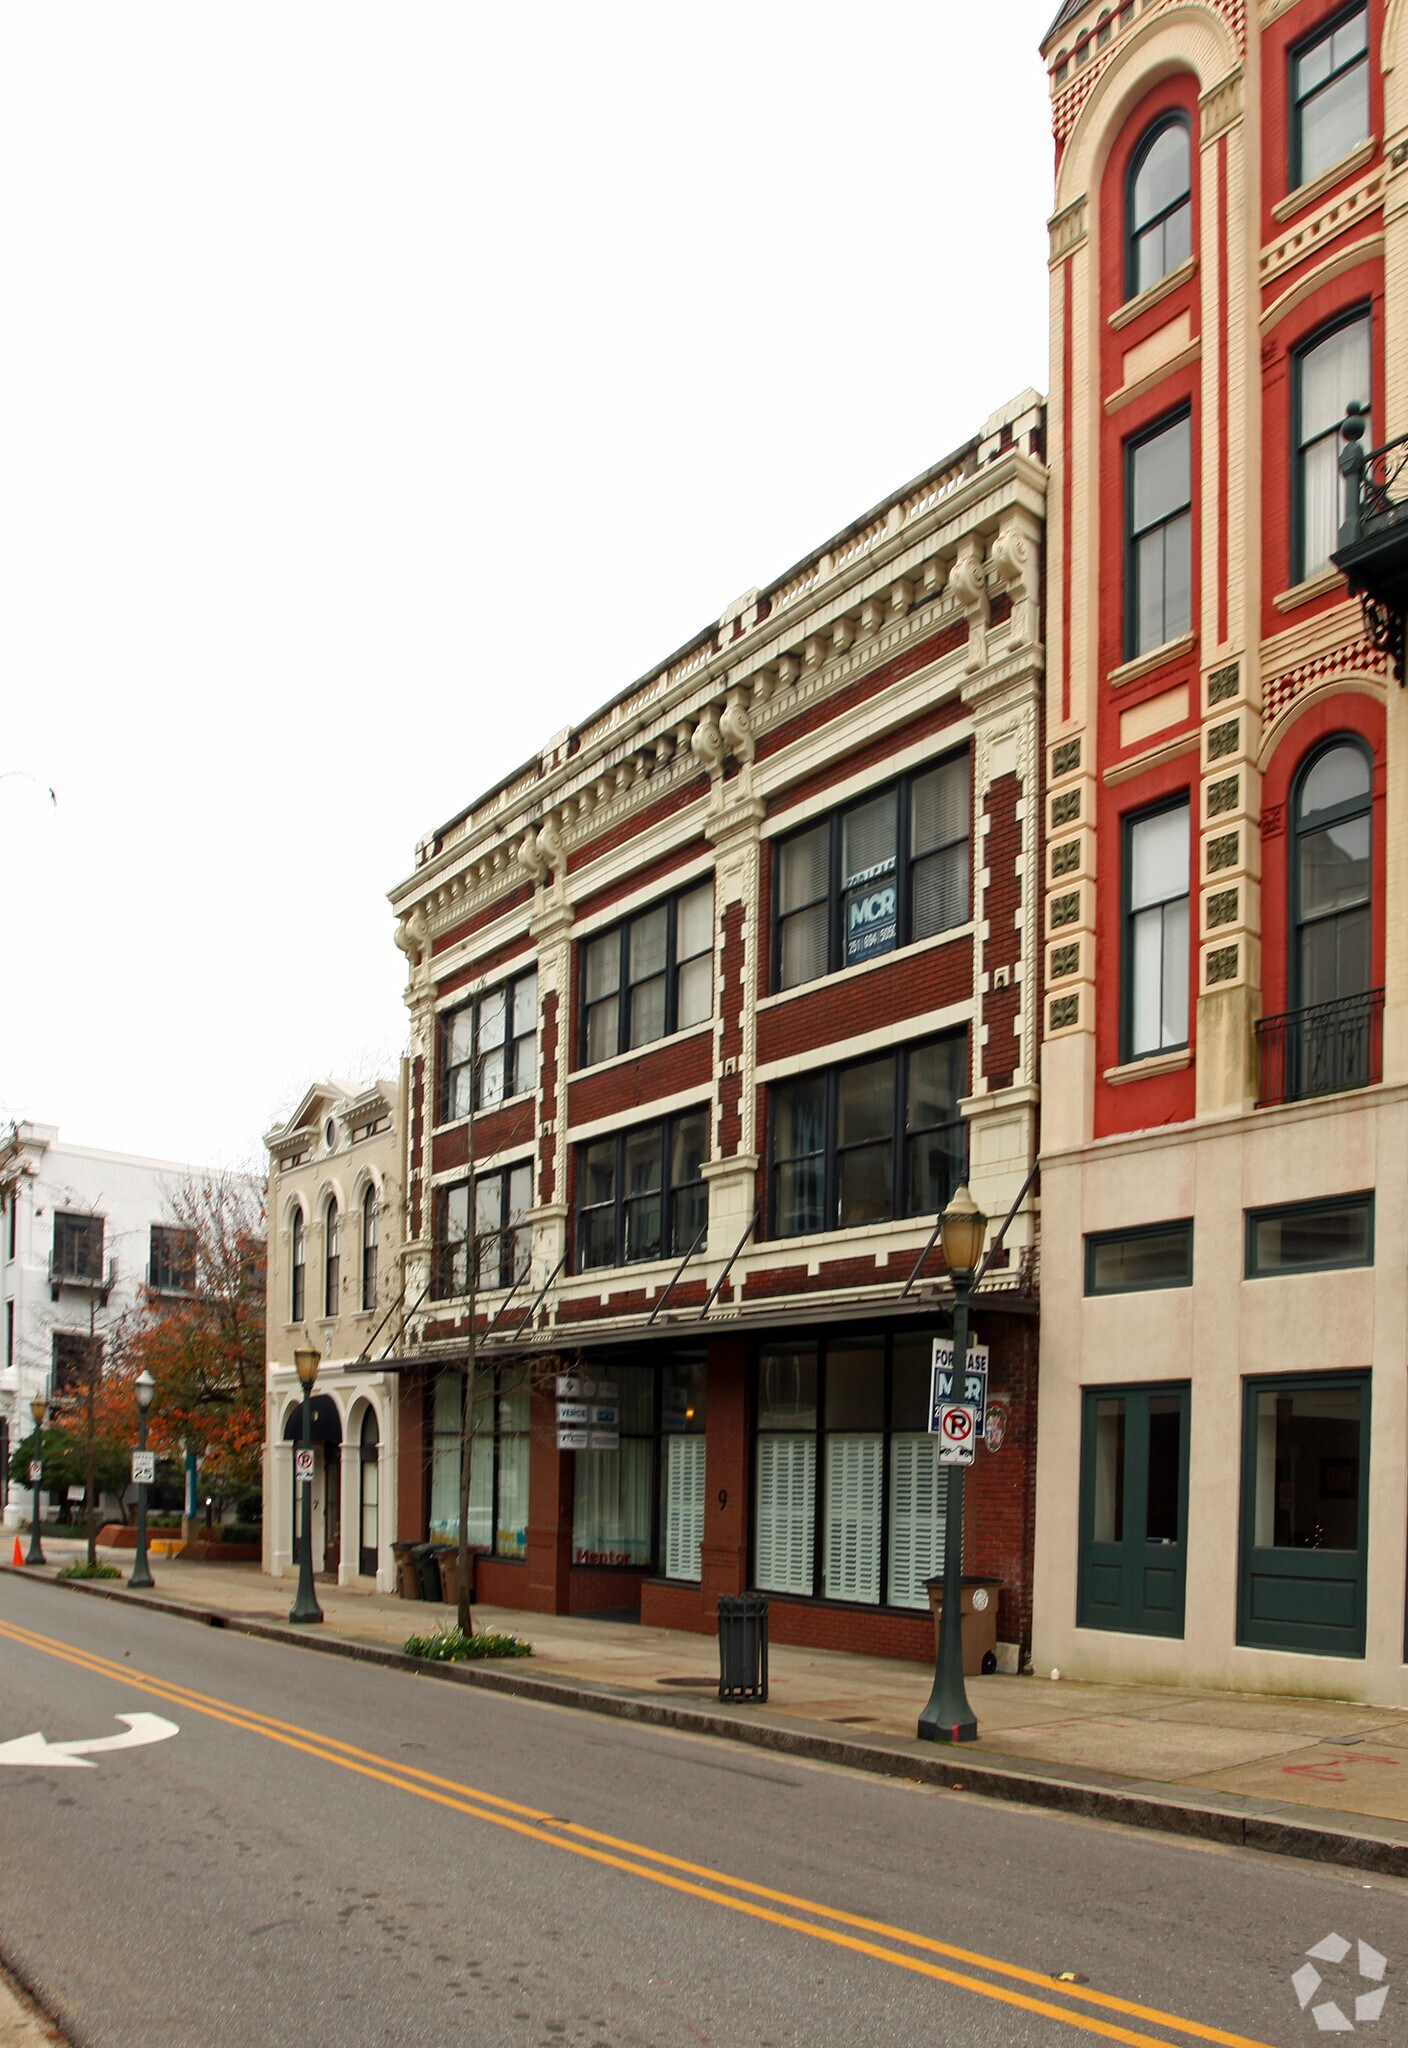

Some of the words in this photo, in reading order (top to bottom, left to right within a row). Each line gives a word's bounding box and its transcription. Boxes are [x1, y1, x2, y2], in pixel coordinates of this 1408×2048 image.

[850, 888, 896, 932] MCR
[968, 1354, 986, 1371] ASE
[938, 1373, 981, 1399] MR
[134, 1467, 152, 1480] 25
[718, 1489, 728, 1511] 9
